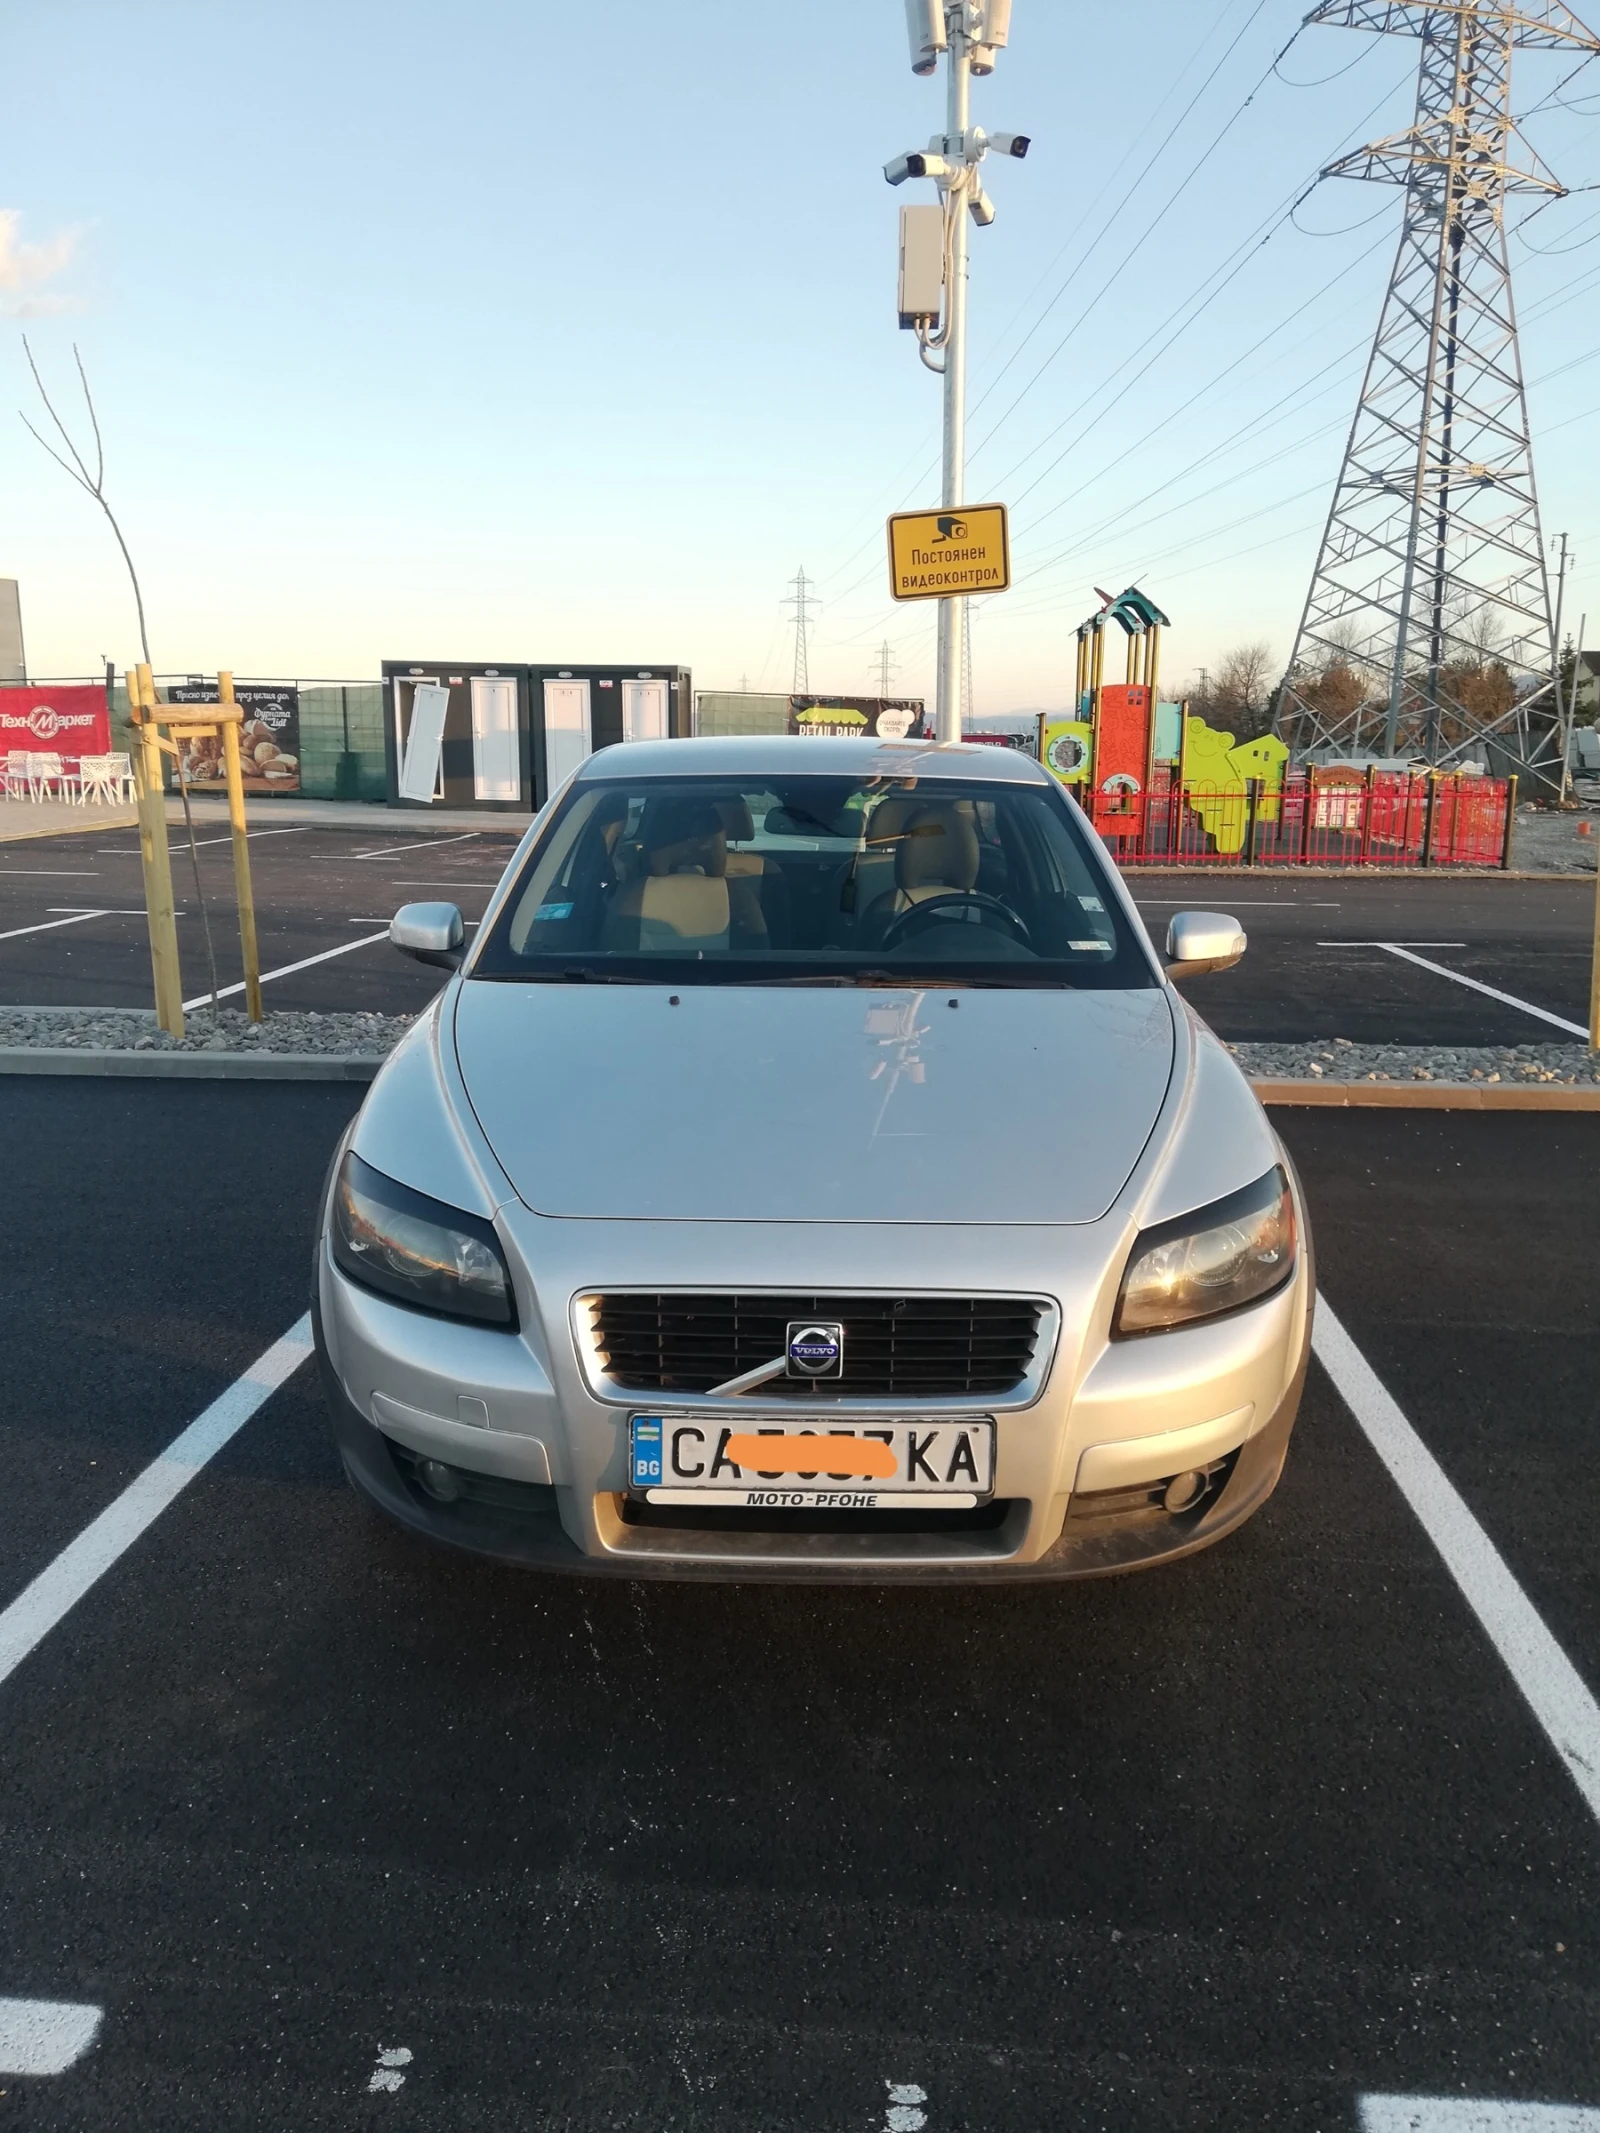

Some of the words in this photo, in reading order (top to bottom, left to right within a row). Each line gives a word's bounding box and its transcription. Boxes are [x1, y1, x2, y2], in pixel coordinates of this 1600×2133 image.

[911, 546, 986, 565] Постоянен
[902, 567, 999, 588] видеоконтрол
[836, 726, 864, 737] PARK
[794, 1347, 835, 1355] VOLVO
[908, 1431, 979, 1483] KA
[637, 1460, 659, 1475] BG
